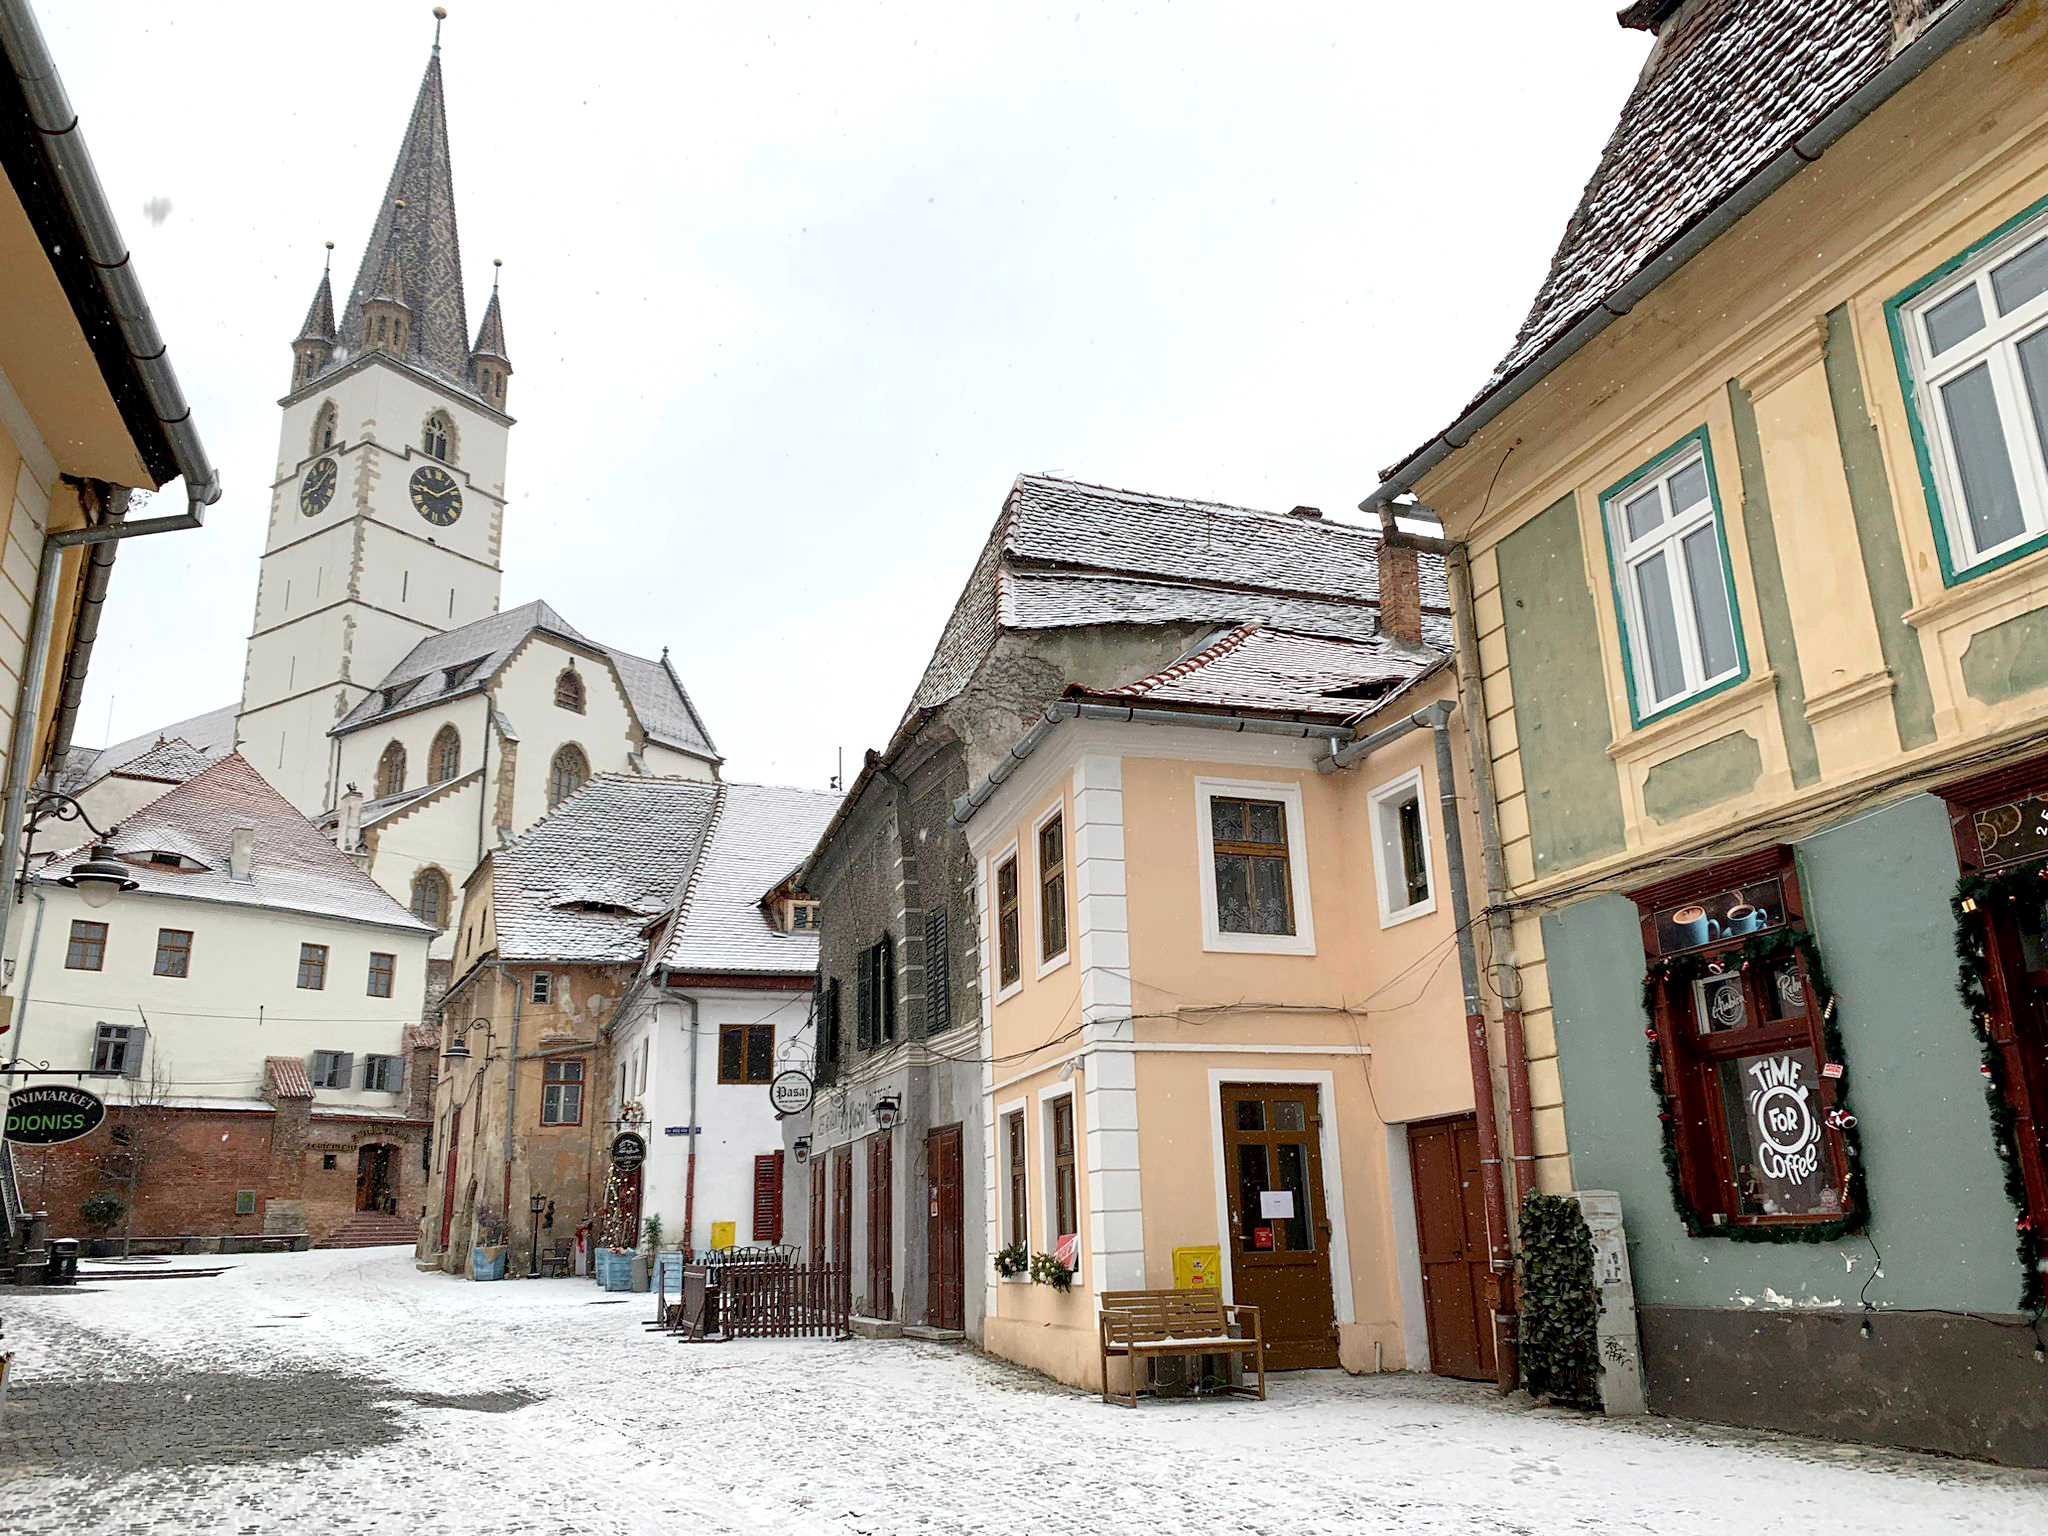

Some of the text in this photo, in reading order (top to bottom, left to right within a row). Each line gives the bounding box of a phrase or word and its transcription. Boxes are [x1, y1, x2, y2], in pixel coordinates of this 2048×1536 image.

[8, 1090, 97, 1111] INIMARKET
[776, 1085, 809, 1100] Pasaj
[7, 1113, 86, 1131] DIONISS
[1758, 1142, 1818, 1186] Coffee
